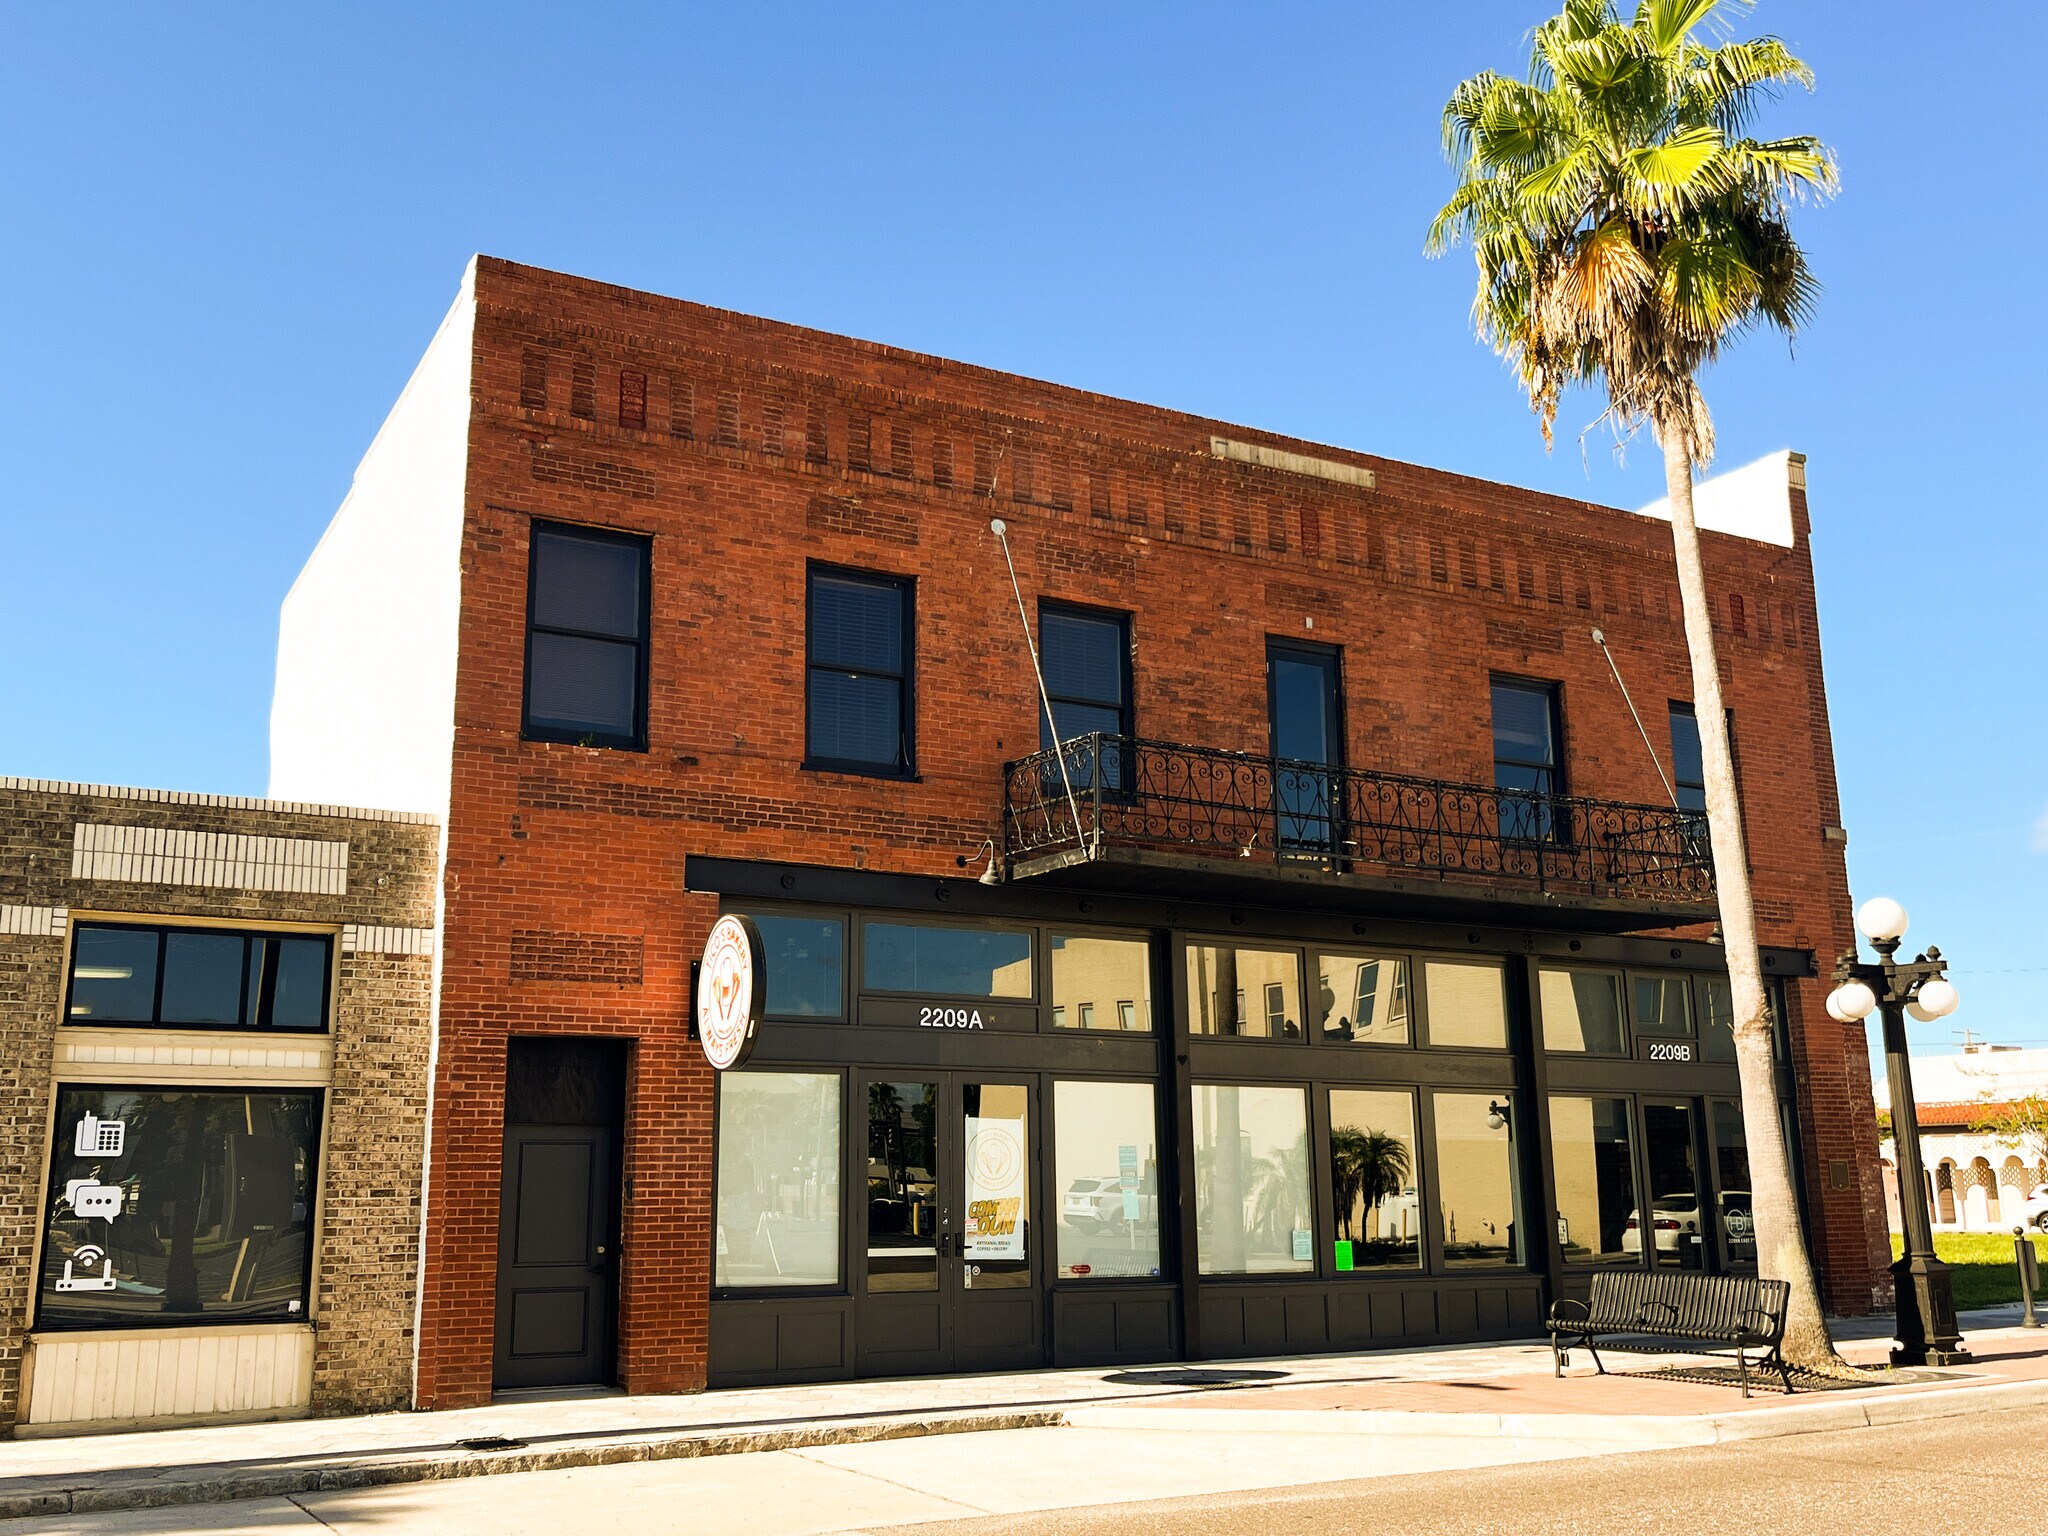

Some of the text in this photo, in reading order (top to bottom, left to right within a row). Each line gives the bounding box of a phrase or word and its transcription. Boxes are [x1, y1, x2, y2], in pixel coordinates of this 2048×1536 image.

[726, 926, 748, 970] BAKERY
[919, 1007, 984, 1030] 2209A
[702, 1007, 746, 1058] ALWAYS FRESH
[1650, 1044, 1691, 1062] 2209B
[968, 1197, 1021, 1219] COMING
[967, 1212, 1016, 1238] OON
